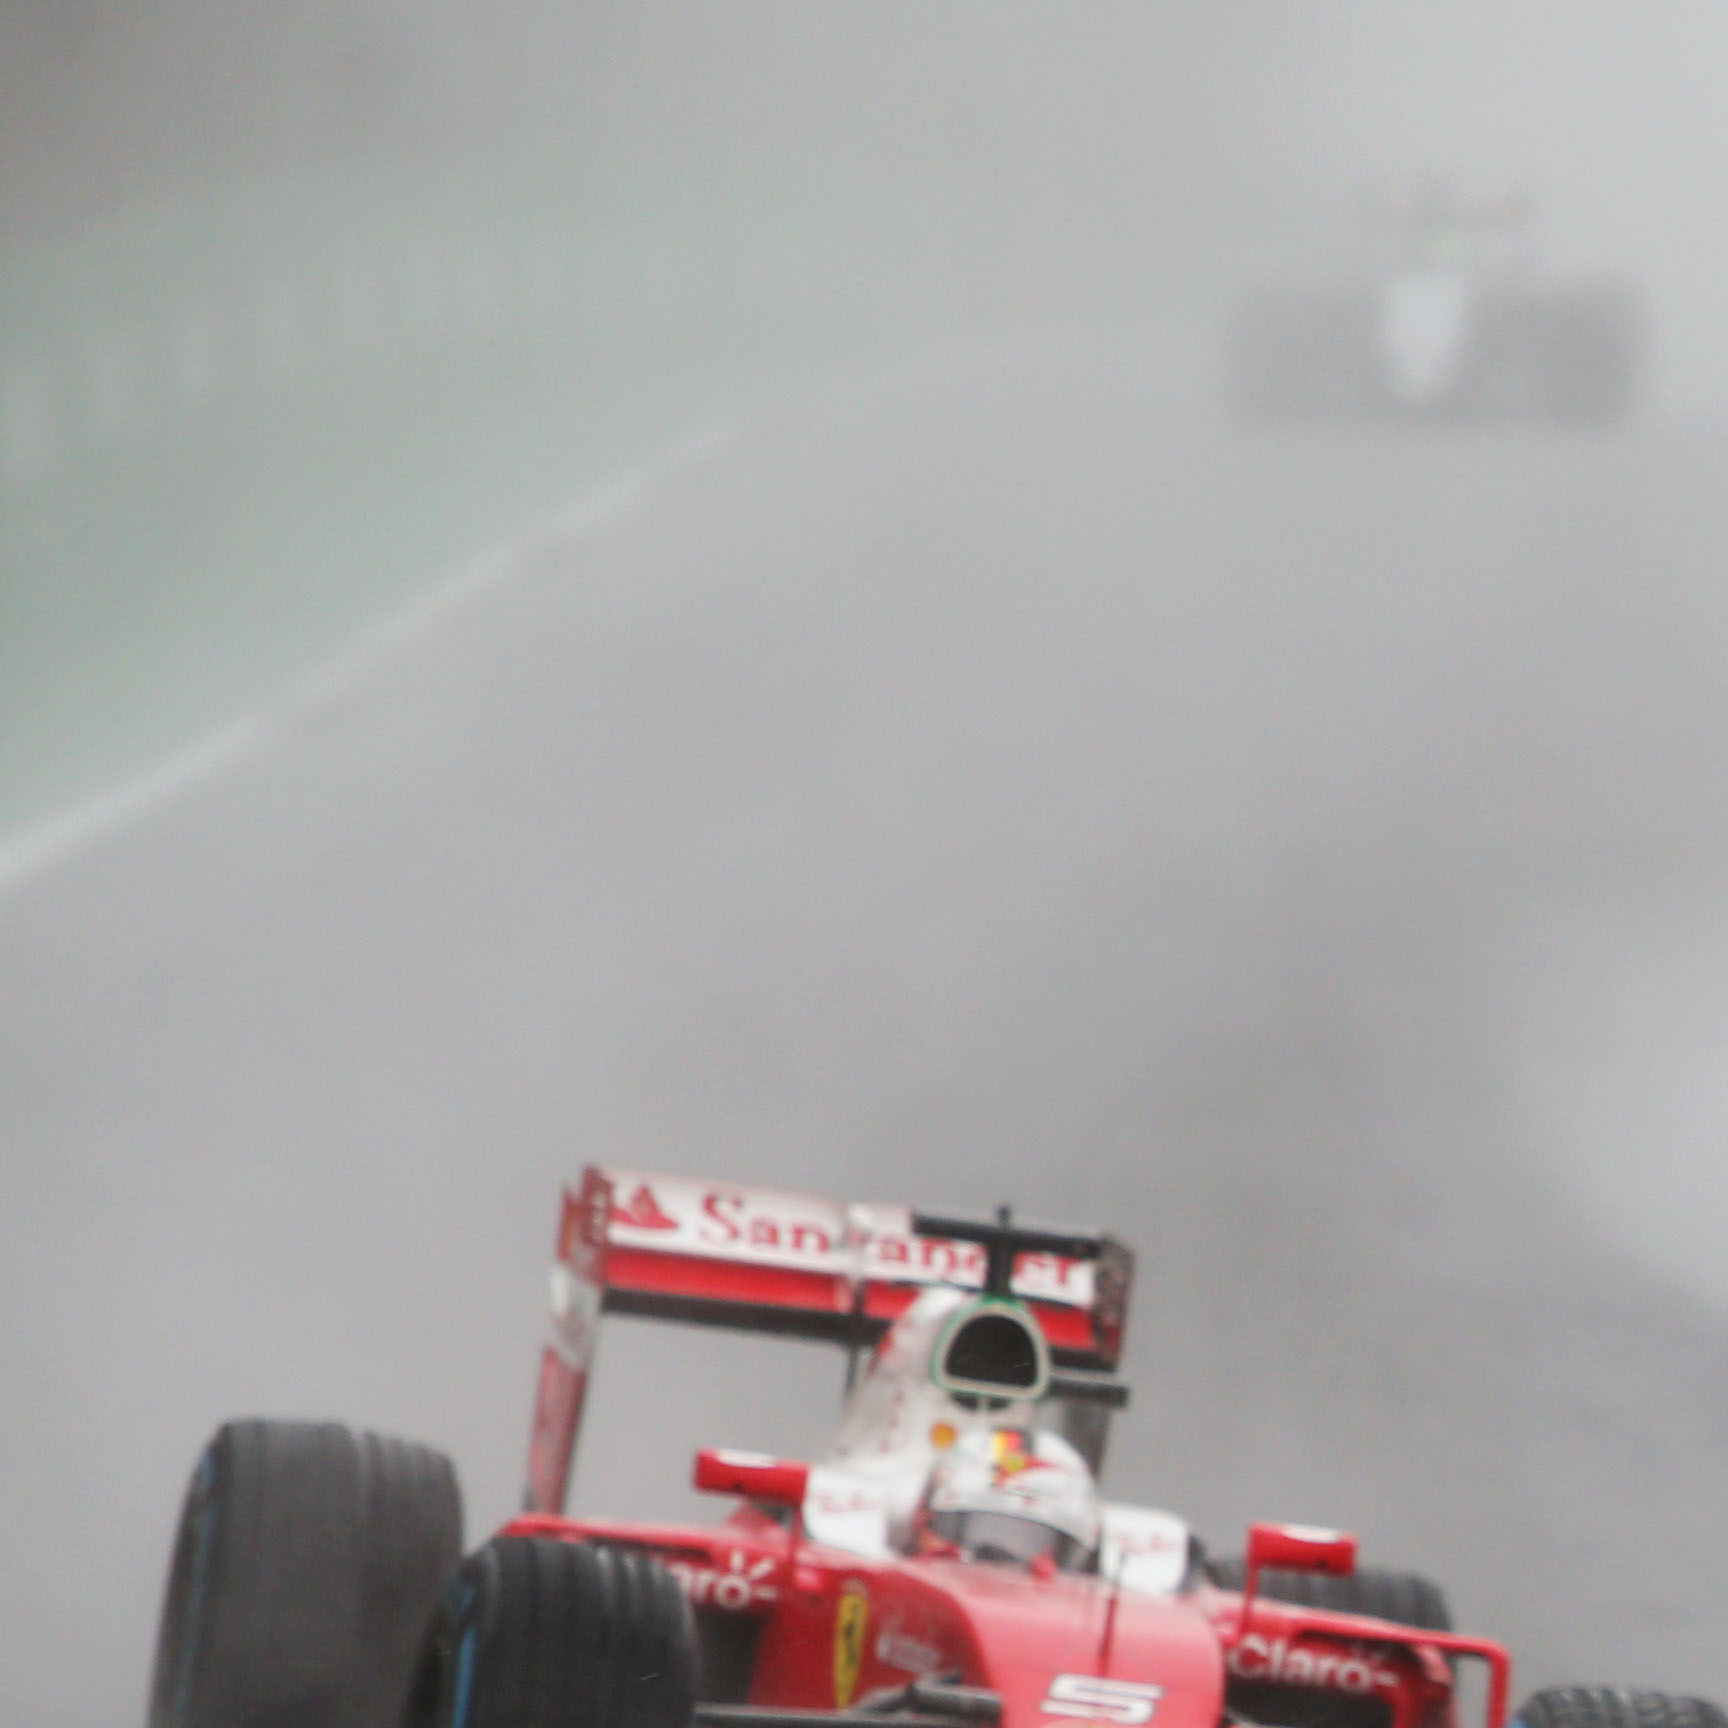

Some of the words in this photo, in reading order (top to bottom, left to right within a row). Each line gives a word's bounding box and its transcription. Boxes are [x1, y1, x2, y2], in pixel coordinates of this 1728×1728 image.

[700, 1192, 1075, 1288] Sananer
[1227, 1634, 1385, 1694] Claro
[1038, 1673, 1165, 1725] 5
